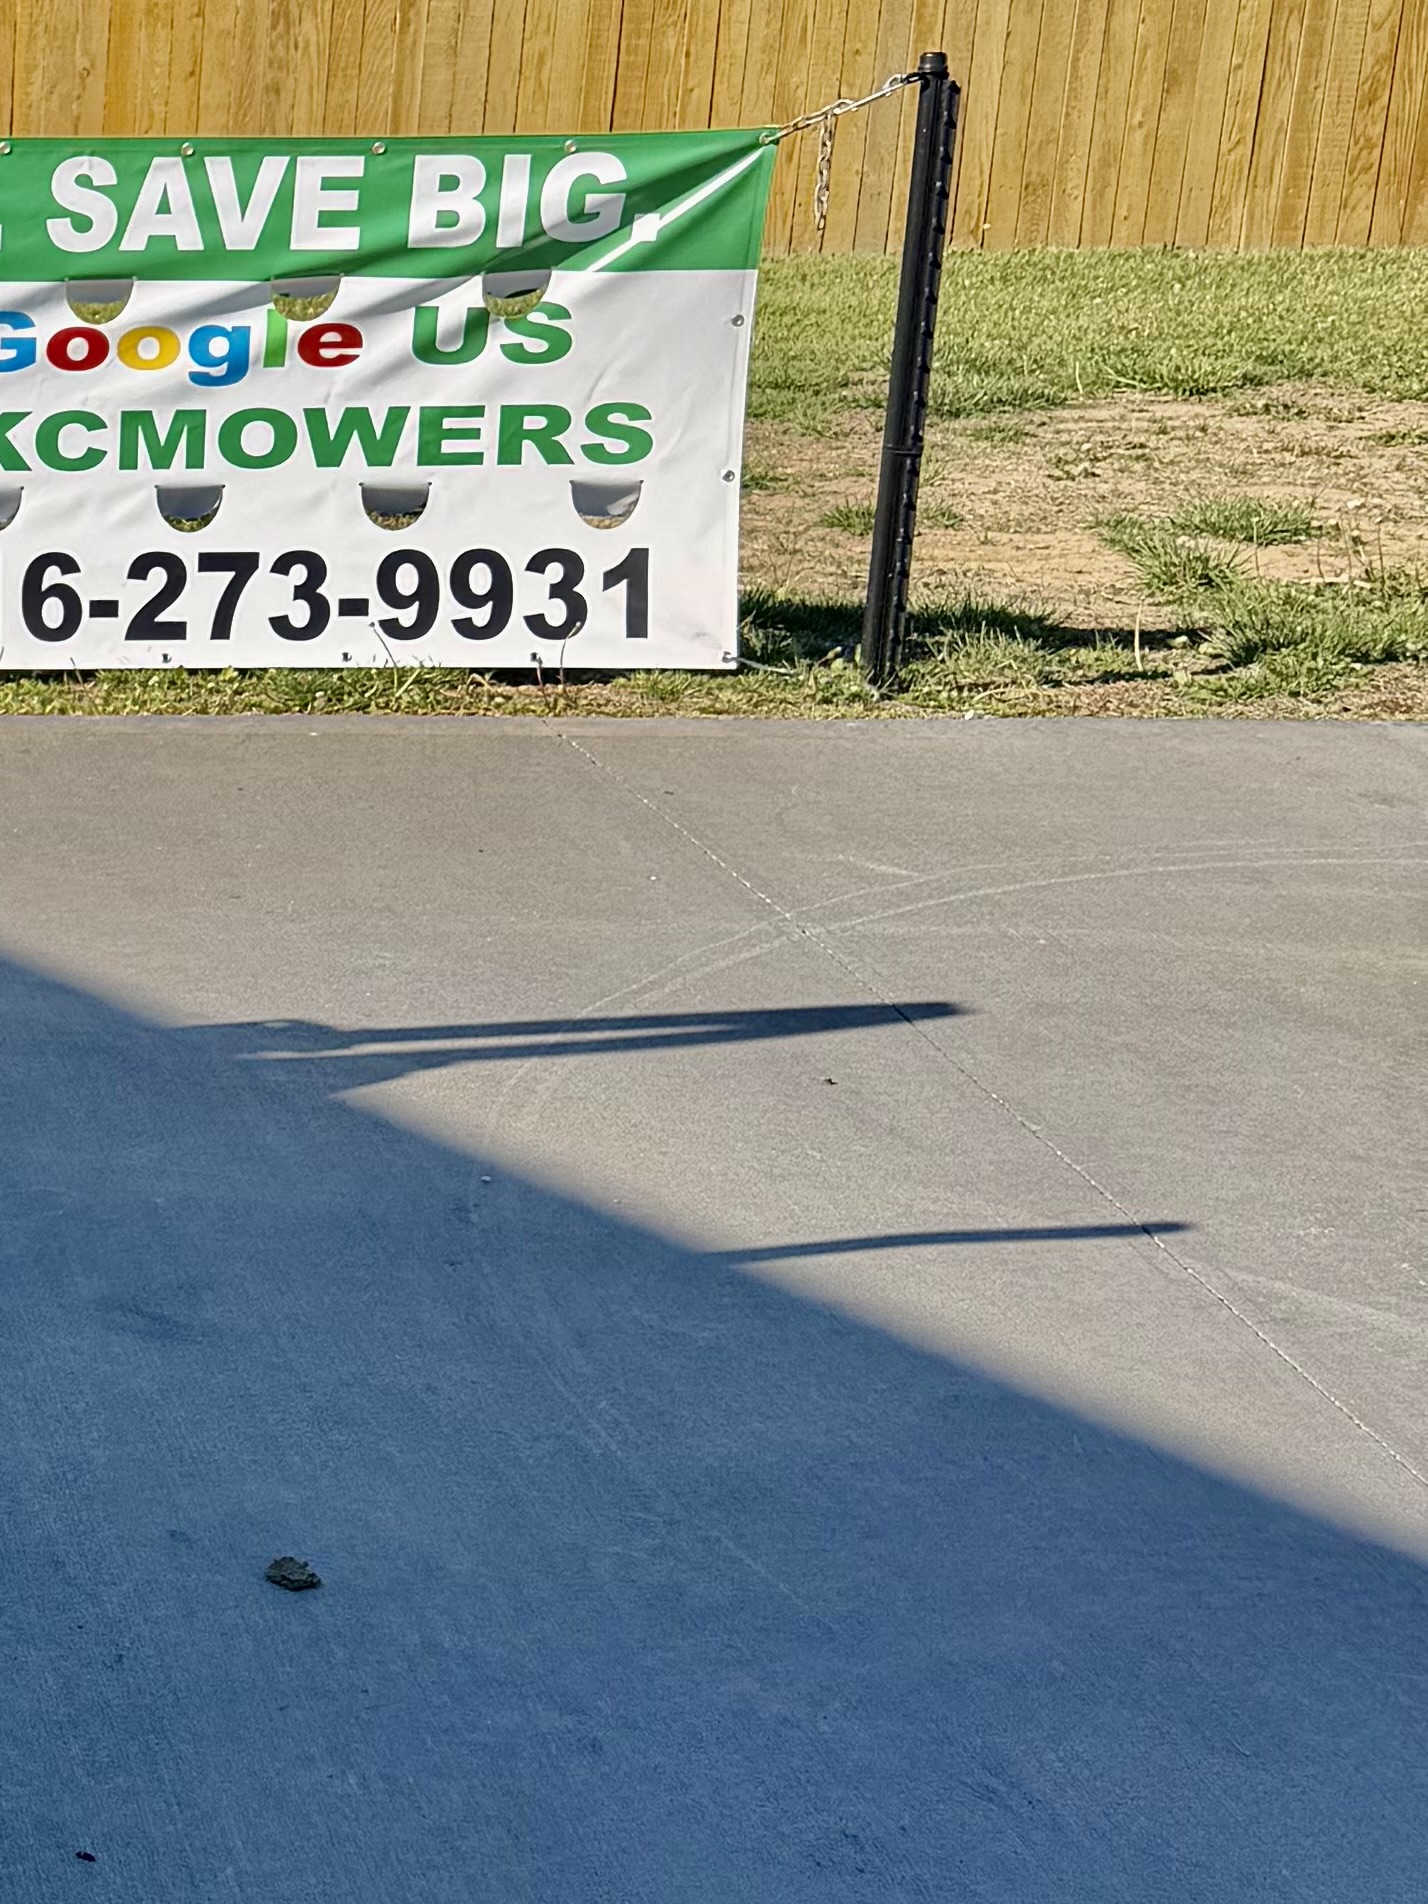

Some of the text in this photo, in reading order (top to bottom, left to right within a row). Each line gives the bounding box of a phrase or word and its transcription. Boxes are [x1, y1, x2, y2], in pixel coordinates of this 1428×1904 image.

[44, 154, 361, 252] SAVE
[408, 151, 661, 249] BIG.
[411, 301, 574, 365] US
